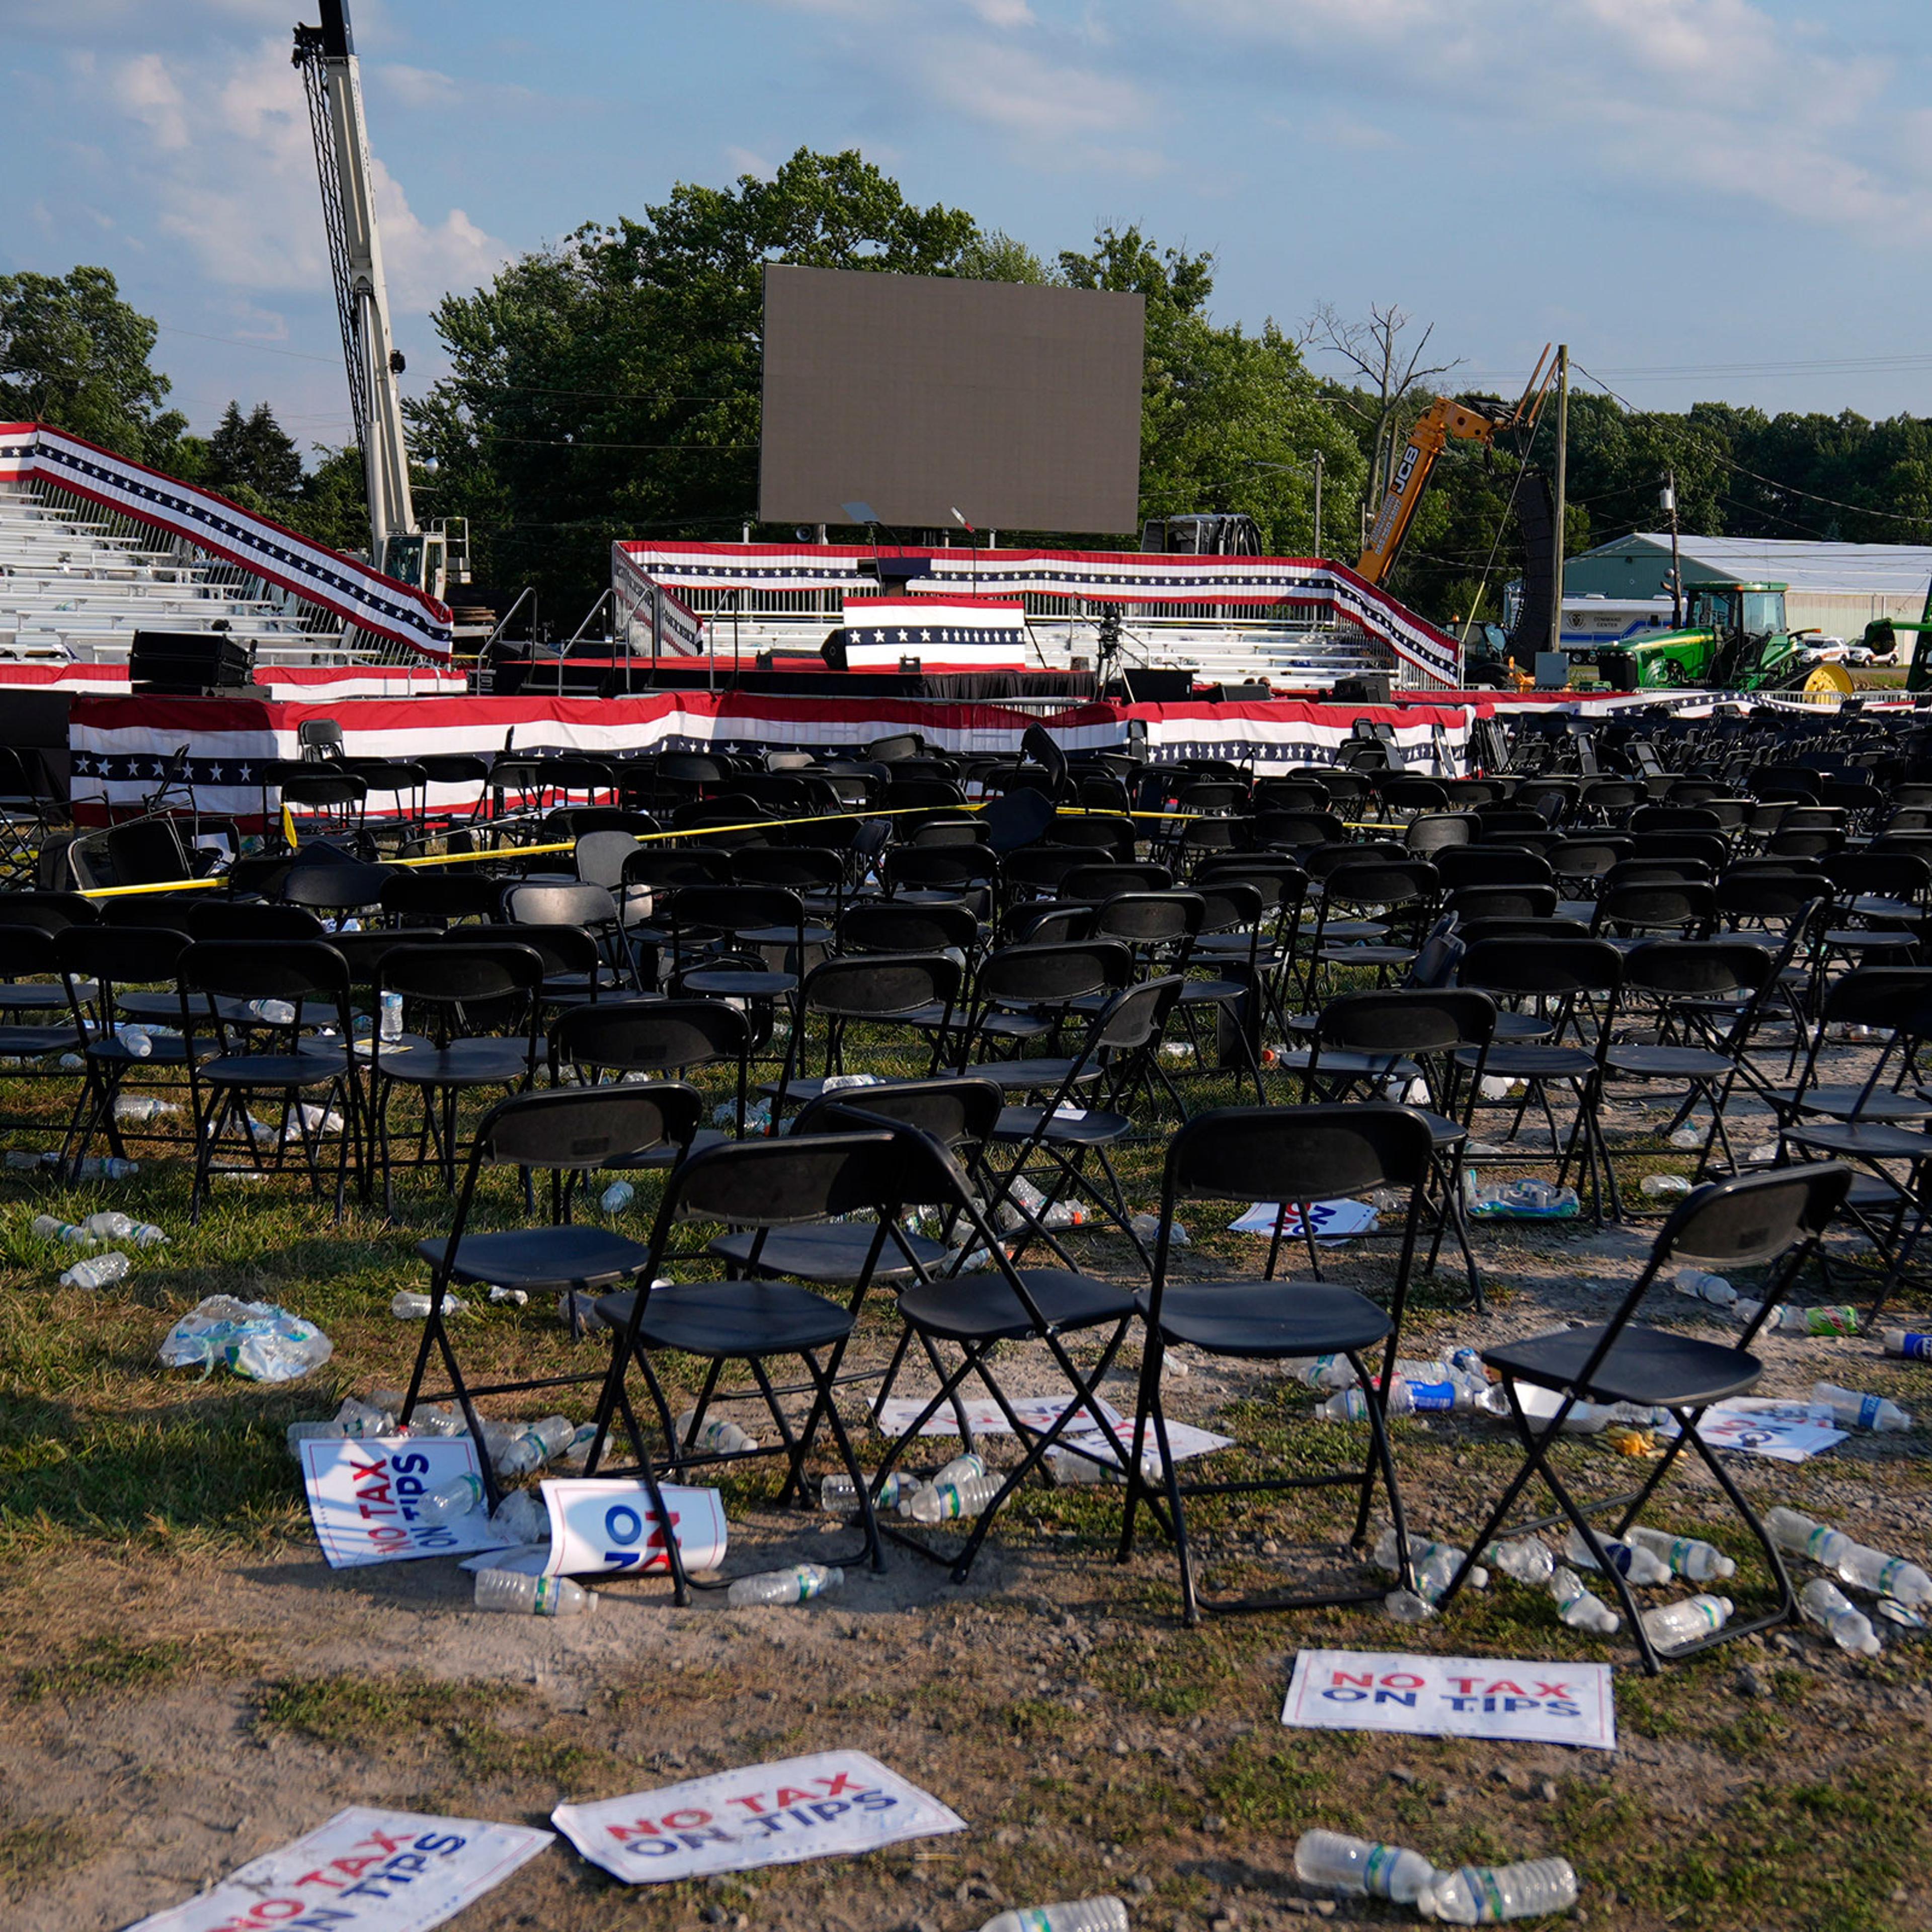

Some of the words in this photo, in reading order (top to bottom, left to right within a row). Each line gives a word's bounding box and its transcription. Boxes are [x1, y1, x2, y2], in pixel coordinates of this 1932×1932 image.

[1395, 445, 1419, 494] JCB
[349, 1459, 398, 1519] TAX
[391, 1453, 430, 1521] TIPS
[367, 1526, 417, 1554] NO
[409, 1525, 459, 1548] ON
[1322, 1687, 1416, 1708] ON
[1440, 1695, 1582, 1717] TIPS
[1331, 1670, 1425, 1688] NO
[1446, 1676, 1573, 1700] TAX
[605, 1808, 714, 1841] NO
[725, 1771, 869, 1813] TAX
[624, 1826, 740, 1857] ON
[743, 1789, 898, 1833] TIPS
[293, 1829, 419, 1888] TAX
[338, 1831, 467, 1899] TIPS
